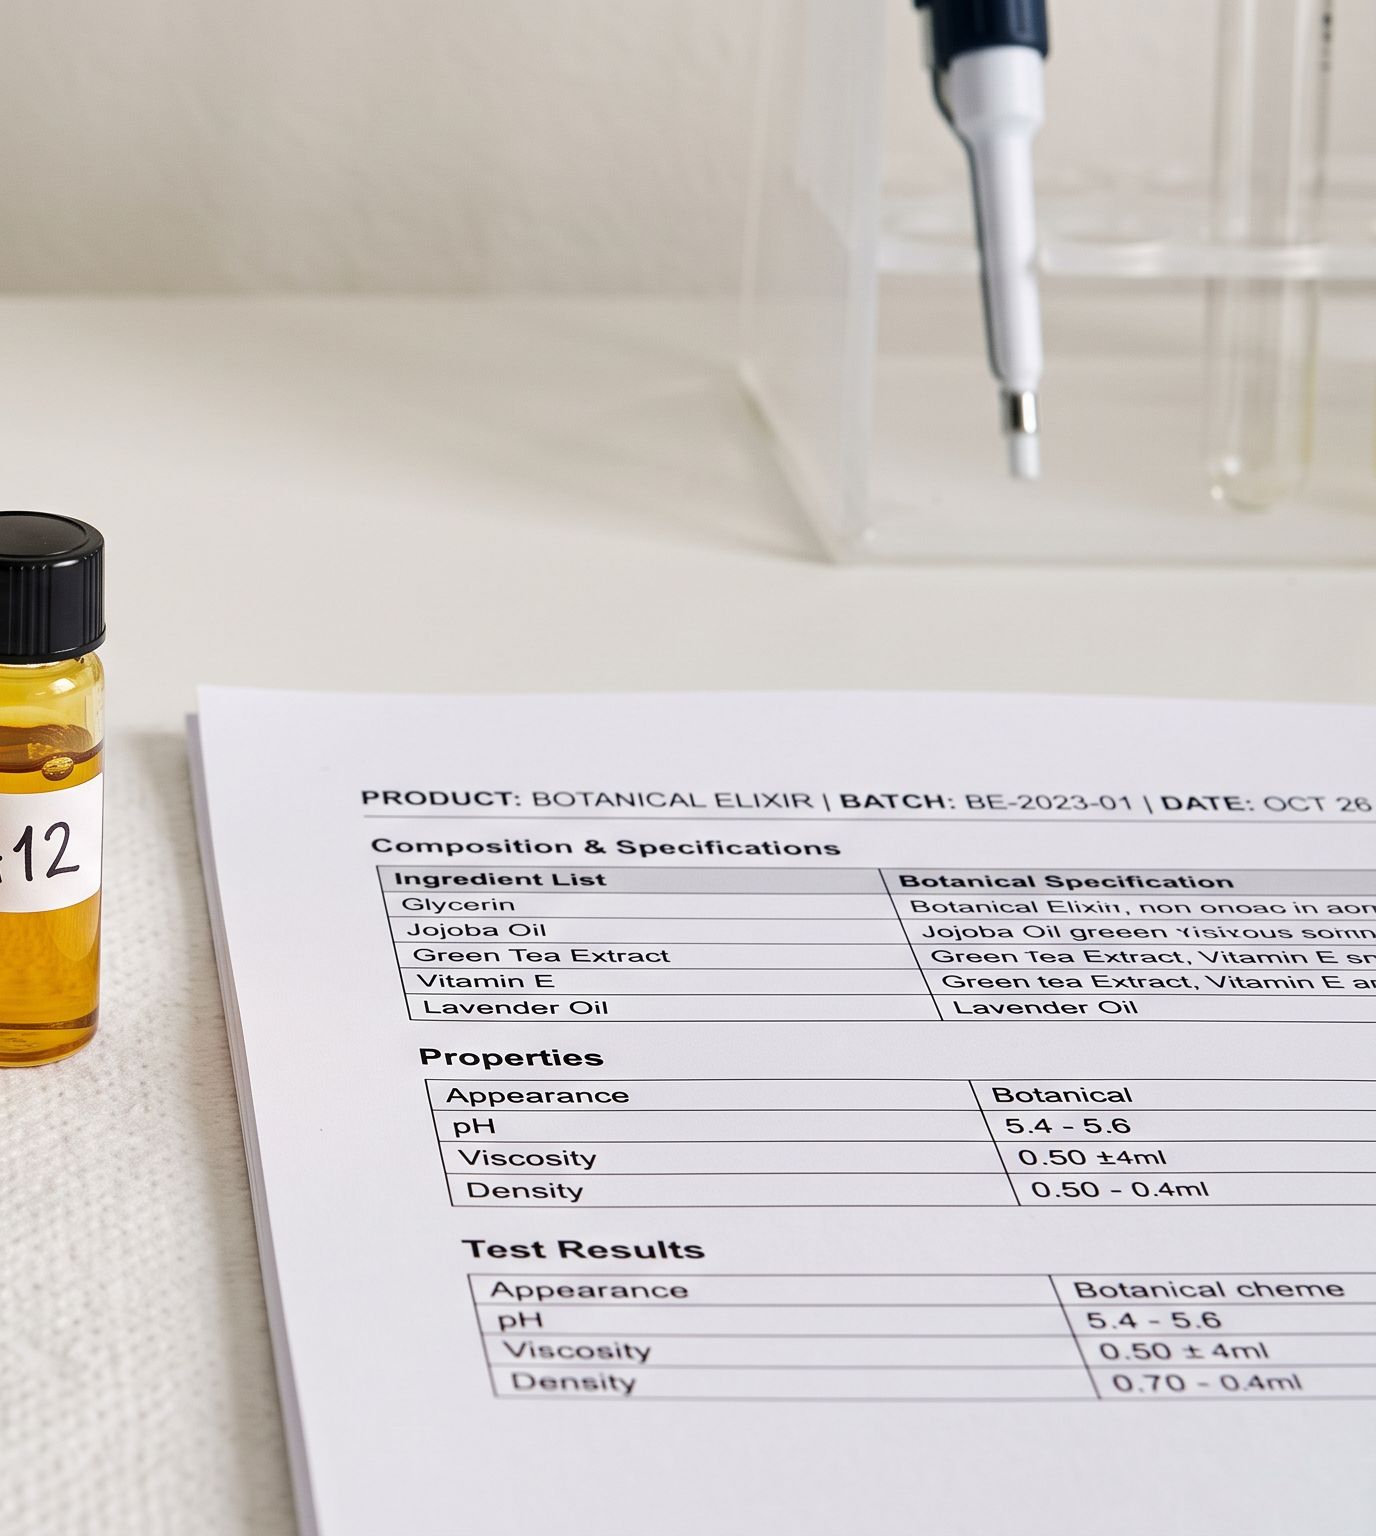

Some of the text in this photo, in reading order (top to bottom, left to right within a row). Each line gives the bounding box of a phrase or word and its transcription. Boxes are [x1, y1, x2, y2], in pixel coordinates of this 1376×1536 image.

[362, 791, 520, 806] PRODUCT:
[533, 792, 706, 807] BOTANICAL
[715, 793, 813, 808] ELIXIR
[840, 794, 955, 809] BATCH:
[966, 795, 1131, 810] BE-2023-01
[1161, 796, 1254, 811] DATE:
[1264, 797, 1323, 811] OCT
[1339, 797, 1372, 811] 26
[372, 838, 841, 858] Composition & Specifications
[395, 873, 607, 888] Ingredient List
[899, 875, 1234, 890] Botanical Specification
[402, 898, 515, 914] Glycerin
[910, 900, 1038, 913] Botanical
[1140, 904, 1191, 913] non
[1293, 902, 1318, 913] in
[407, 923, 546, 939] Jojoba Oil
[922, 926, 1013, 941] Jojoba
[1023, 925, 1061, 938] Oil
[1070, 929, 1167, 941] greeen
[414, 949, 671, 962] Green Tea Extract
[931, 950, 1018, 963] Green
[1024, 951, 1075, 963] Tea
[1083, 950, 1191, 965] Extract,
[1198, 951, 1308, 963] Vitamin
[1316, 951, 1338, 963] E
[417, 974, 555, 988] Vitamin E
[942, 975, 1030, 988] Green
[1037, 976, 1083, 988] tea
[1091, 975, 1199, 990] Extract,
[1205, 976, 1314, 988] Vitamin
[1321, 976, 1344, 988] E
[424, 1001, 608, 1014] Lavender Oil
[953, 1001, 1138, 1014] Lavender Oil
[420, 1048, 603, 1070] Properties
[446, 1088, 629, 1107] Appearance
[992, 1087, 1132, 1103] Botanical
[453, 1118, 495, 1138] pH
[1006, 1119, 1052, 1133] 5.4
[1084, 1118, 1131, 1133] 5.6
[458, 1150, 596, 1170] Viscosity
[1019, 1150, 1086, 1165] 0.50
[467, 1182, 583, 1203] Density
[1032, 1182, 1099, 1197] 0.50
[1132, 1182, 1209, 1197] 0.4ml
[461, 1240, 705, 1259] Test Results
[491, 1282, 688, 1301] Appearance
[1074, 1281, 1344, 1298] Botanical cheme
[498, 1312, 542, 1332] pH
[1087, 1313, 1136, 1329] 5.4
[1172, 1312, 1221, 1328] 5.6
[504, 1342, 650, 1364] Viscosity
[1100, 1343, 1171, 1360] 0.50
[1213, 1343, 1268, 1358] 4ml
[512, 1373, 635, 1396] Density
[1113, 1375, 1185, 1392] 0.70
[1221, 1374, 1302, 1390] 0.4ml
